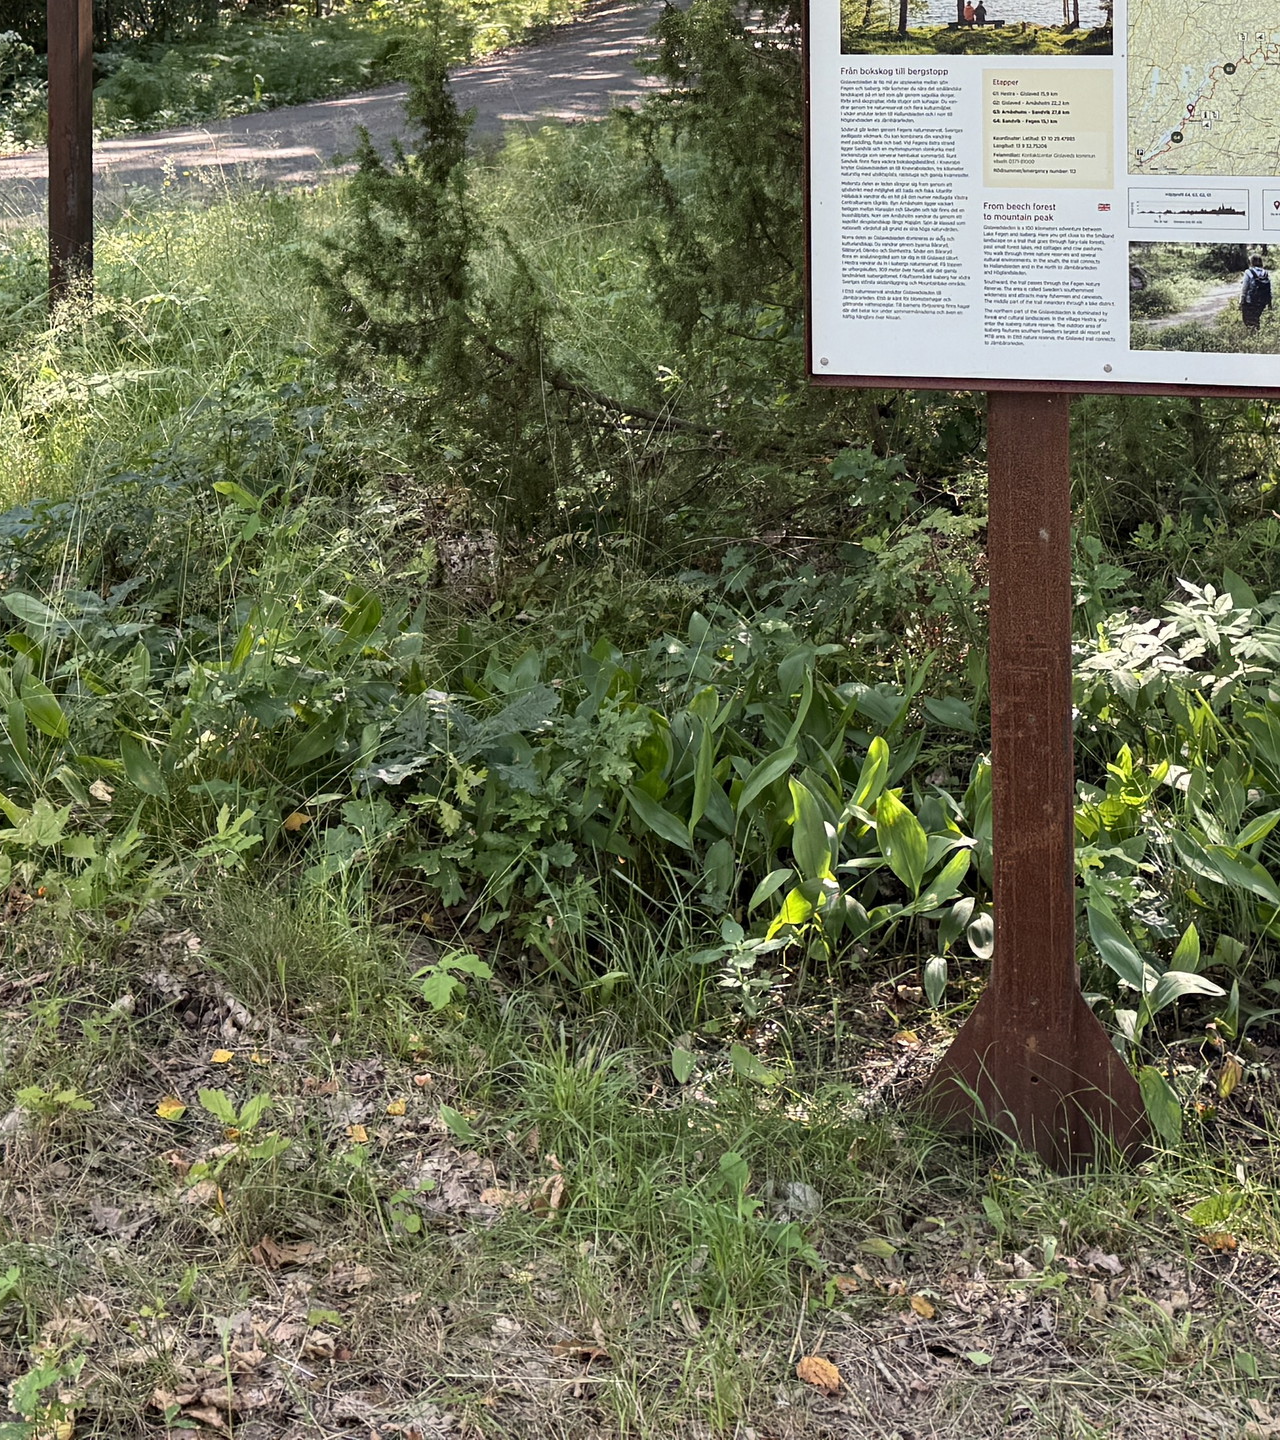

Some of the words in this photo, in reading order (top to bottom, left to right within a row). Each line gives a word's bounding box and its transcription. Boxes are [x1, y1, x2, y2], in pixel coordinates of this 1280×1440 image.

[860, 68, 893, 77] bokskog
[908, 68, 948, 78] bergstopp
[1034, 213, 1053, 222] peak
